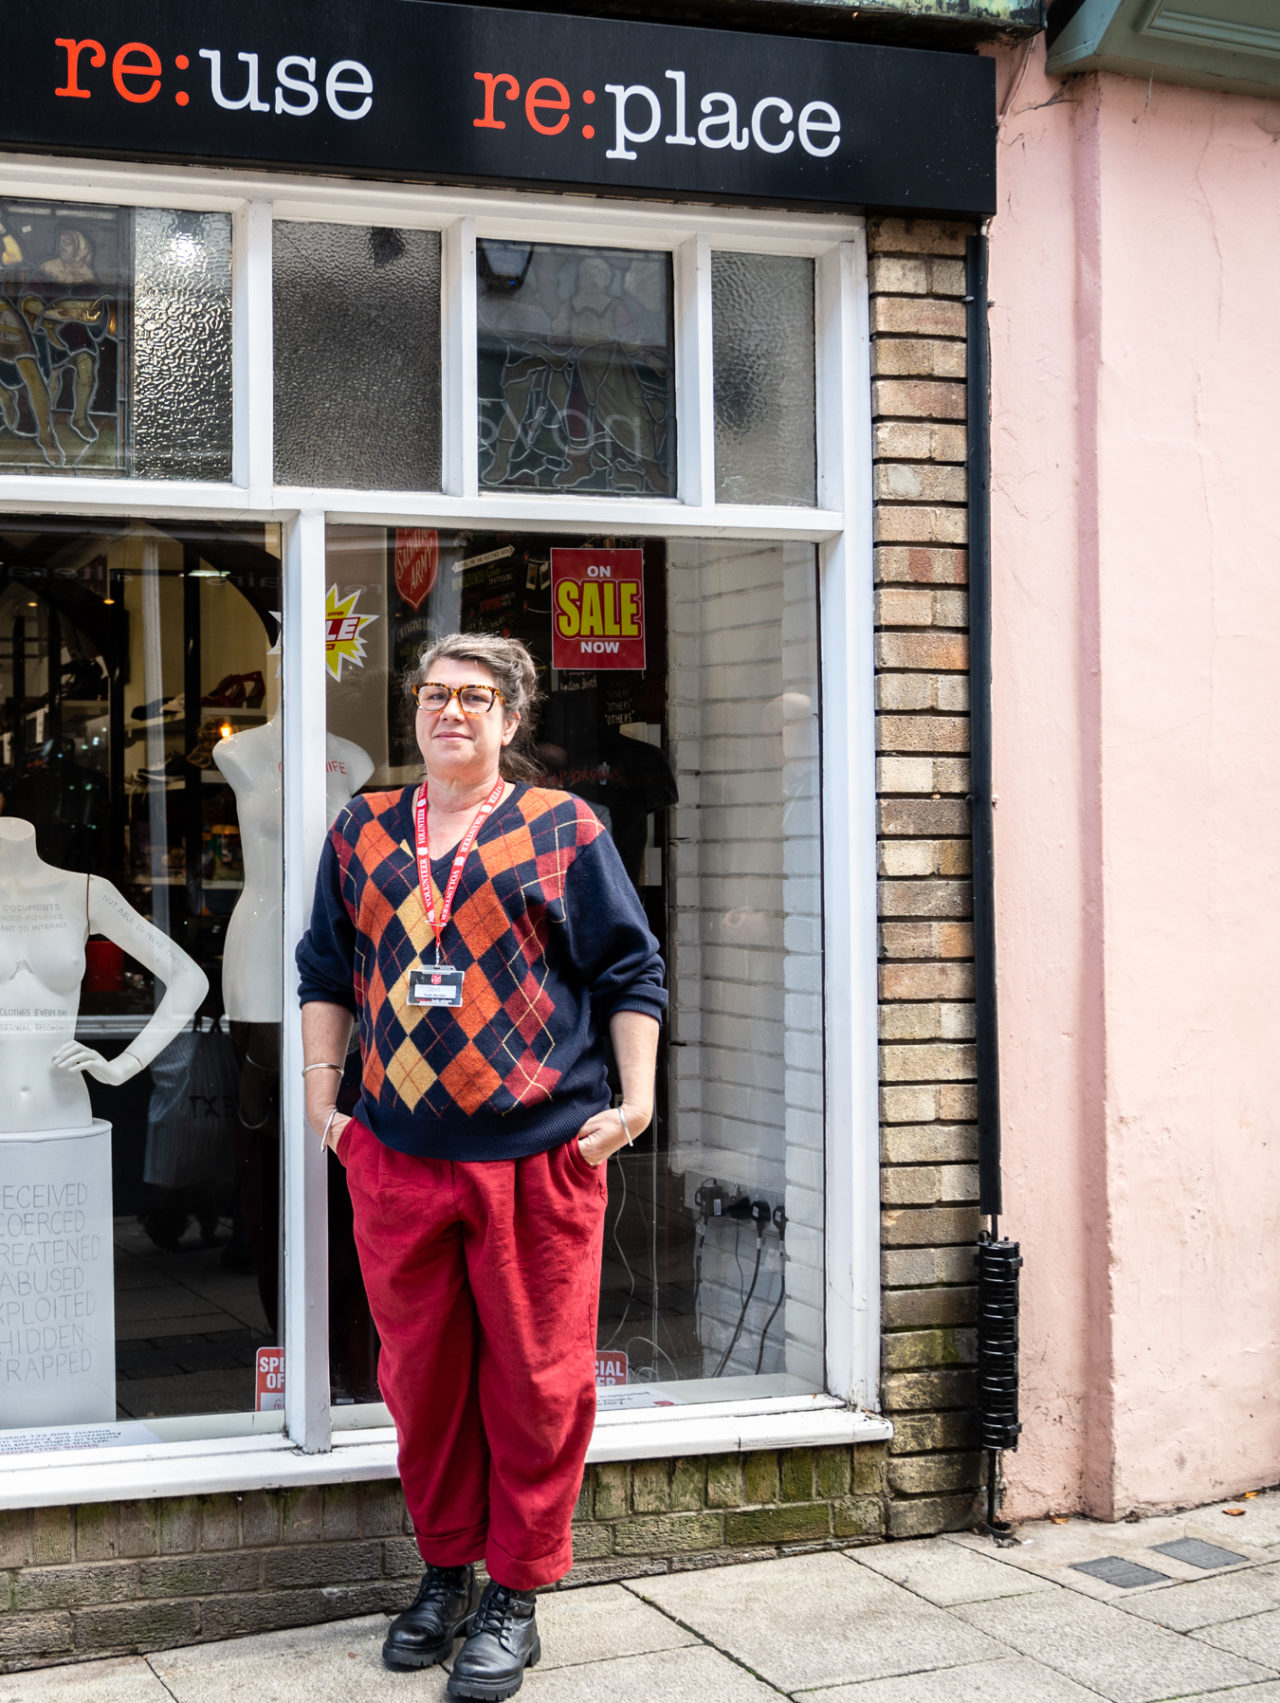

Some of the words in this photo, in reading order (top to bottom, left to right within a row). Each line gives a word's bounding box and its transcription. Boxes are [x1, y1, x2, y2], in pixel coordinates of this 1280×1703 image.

[55, 37, 373, 120] re:use
[473, 69, 840, 160] re:place
[587, 565, 611, 578] ON
[557, 581, 639, 636] SALE
[581, 641, 620, 654] NOW
[417, 808, 426, 845] VOLUNTEER
[460, 814, 486, 853] VOLUNTEER
[420, 859, 432, 908] VOLUNTEER
[441, 870, 460, 920] VOLUNTEER
[3, 903, 61, 912] DOCUMENTS
